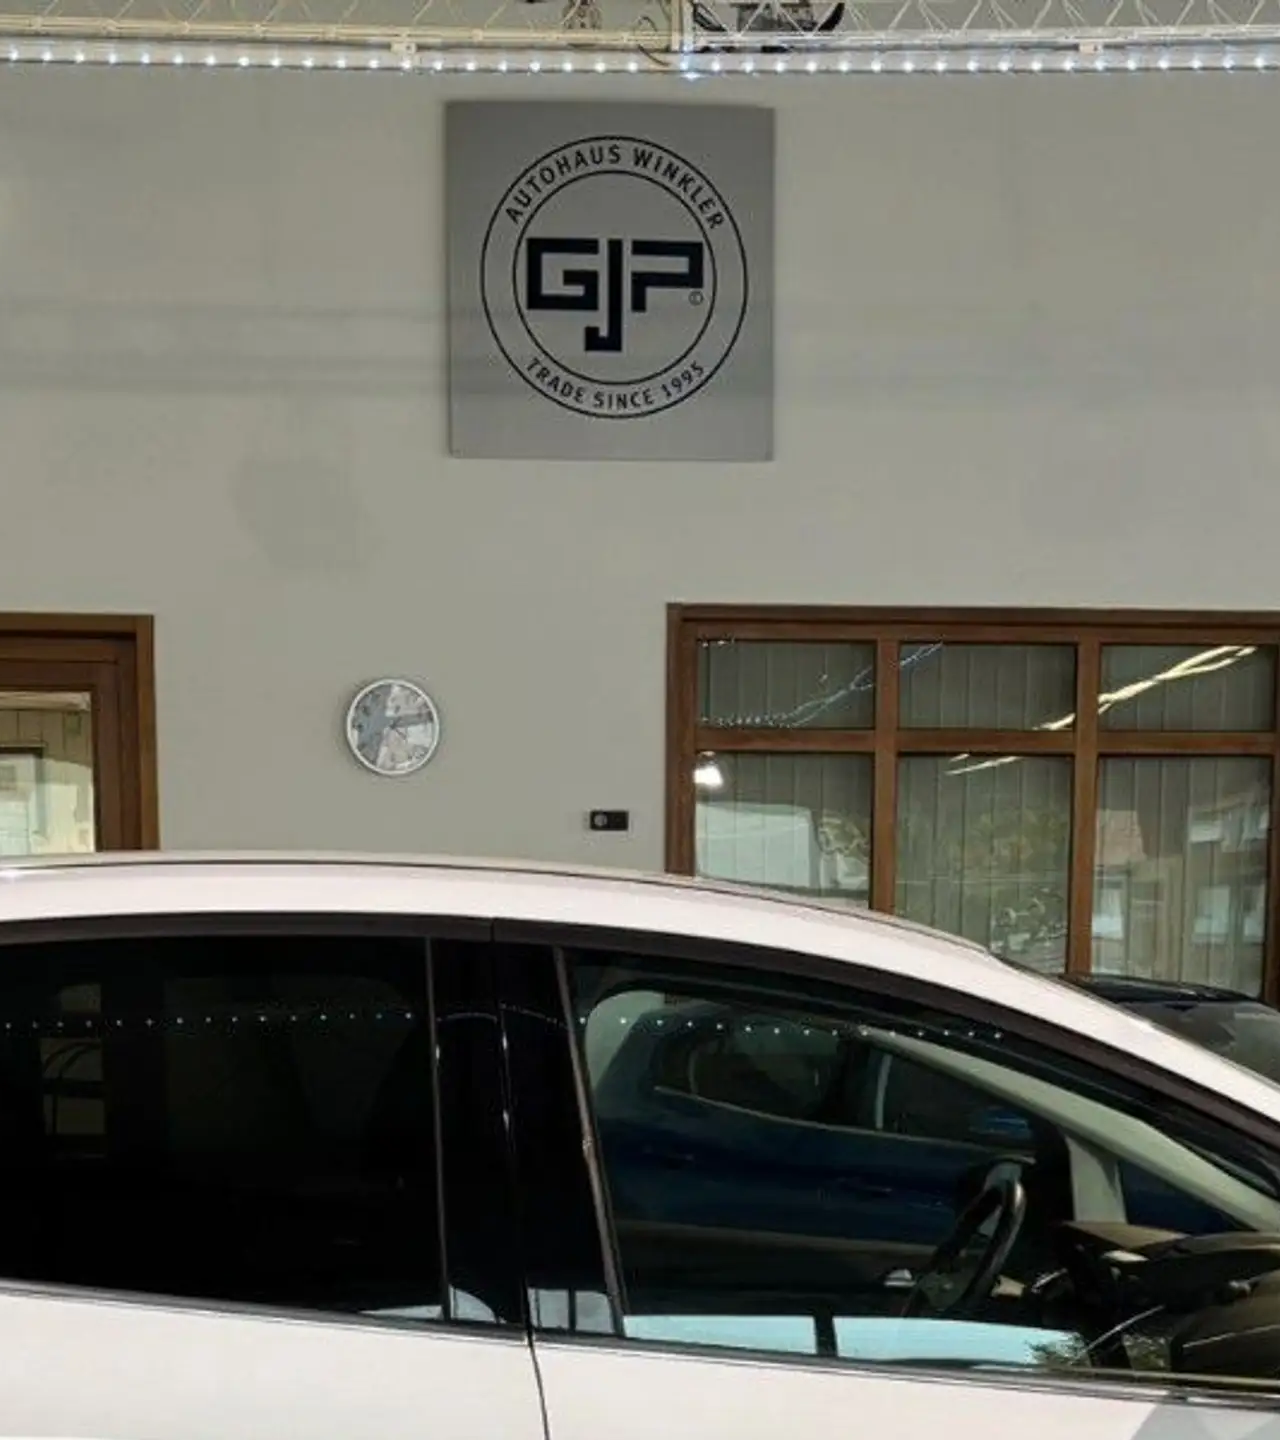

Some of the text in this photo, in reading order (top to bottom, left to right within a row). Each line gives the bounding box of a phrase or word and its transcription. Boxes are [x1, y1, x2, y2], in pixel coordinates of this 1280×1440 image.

[505, 144, 724, 229] AUTOHAUS WINKLER
[526, 237, 704, 353] GJP
[524, 357, 705, 410] TRADE SINCE 1995
